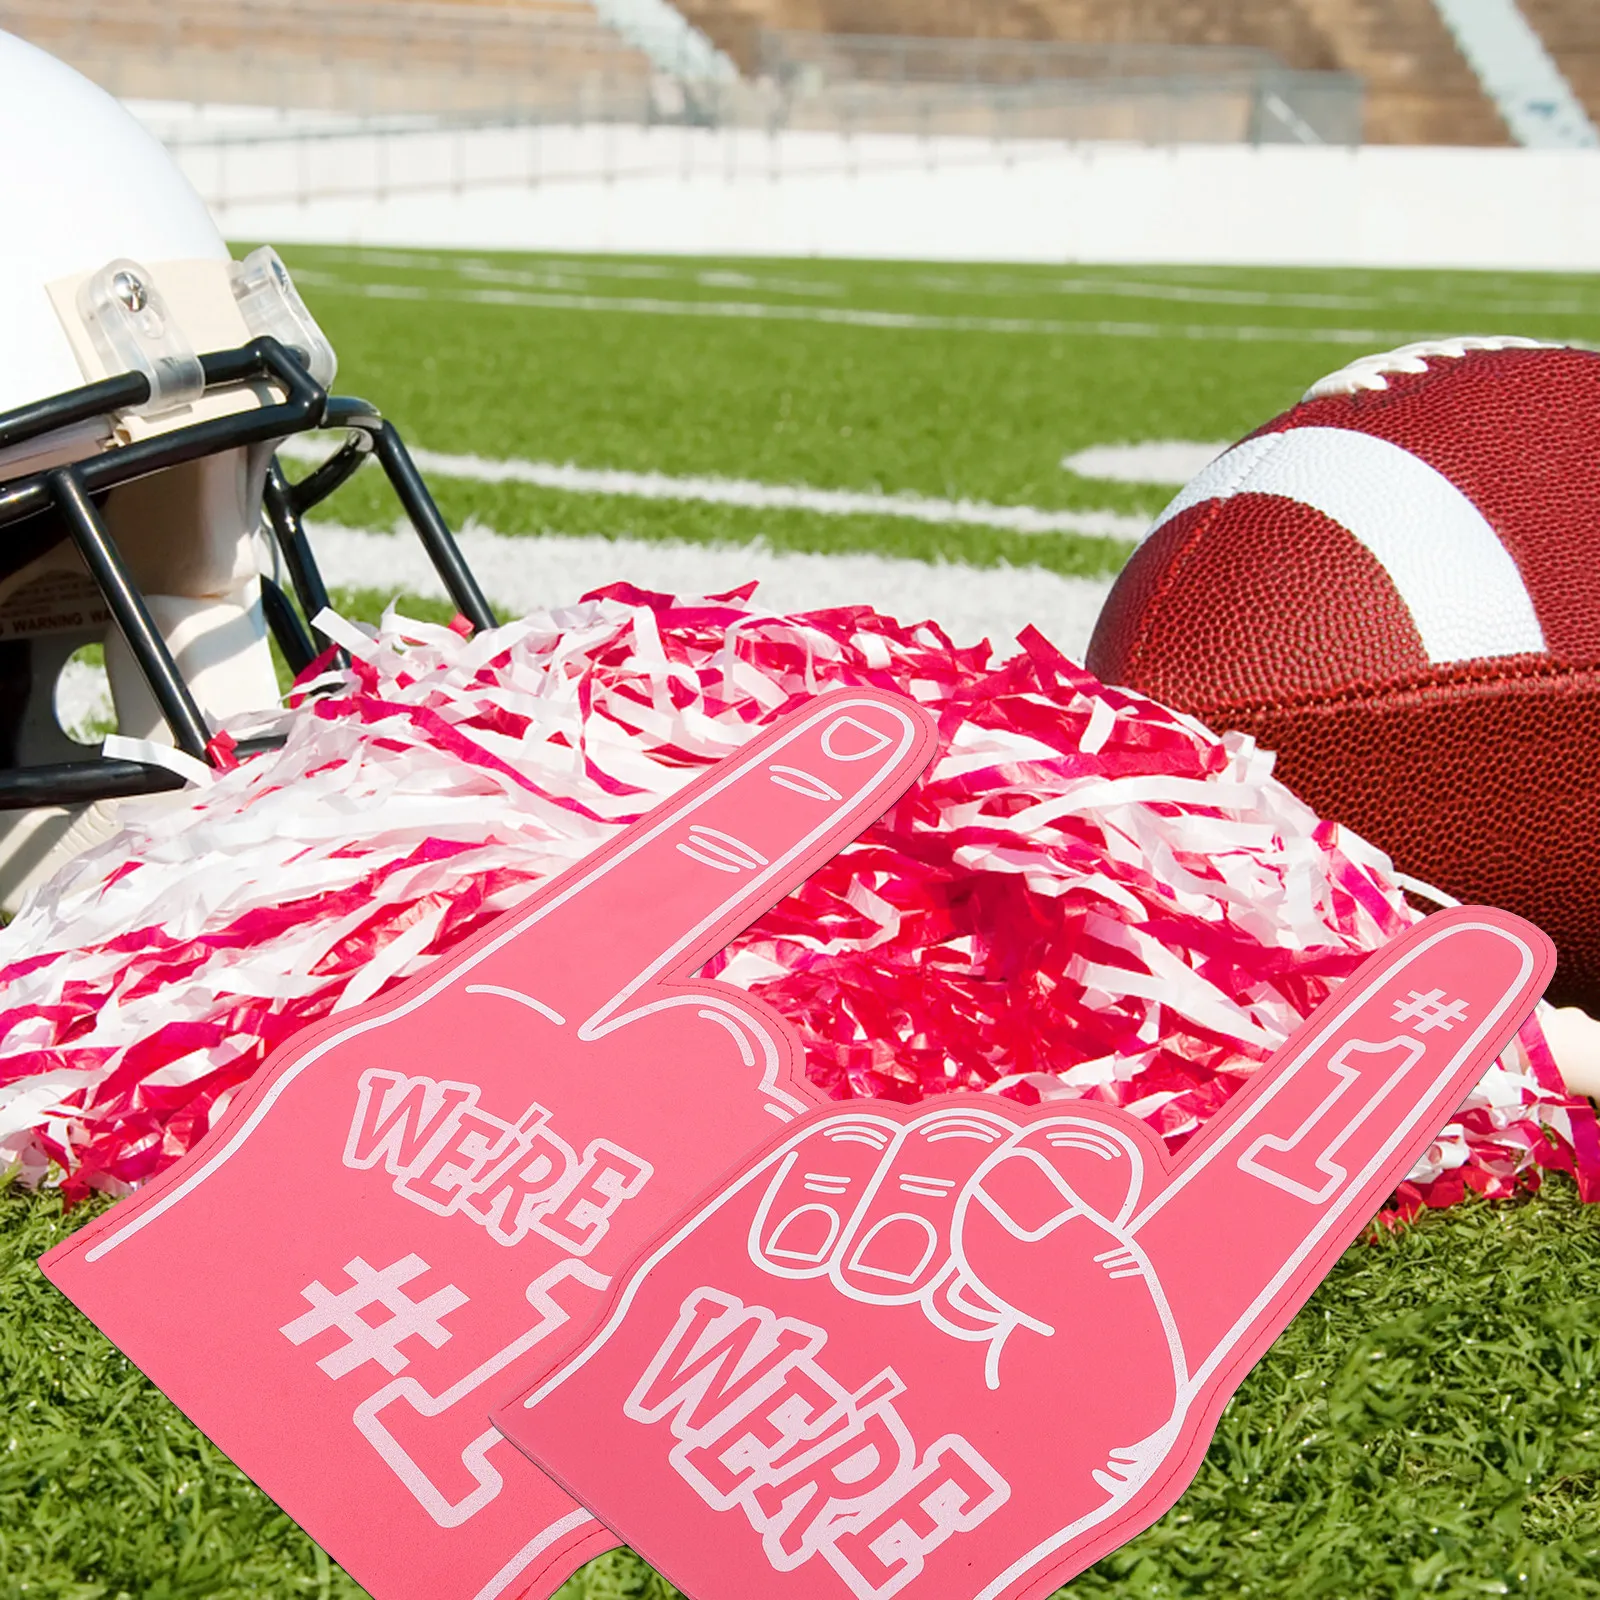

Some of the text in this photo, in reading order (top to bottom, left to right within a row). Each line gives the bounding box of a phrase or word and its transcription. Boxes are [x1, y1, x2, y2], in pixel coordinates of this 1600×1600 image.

[12, 611, 84, 634] WARNING
[342, 1067, 655, 1257] WE'RE
[623, 1286, 1011, 1600] WE'RE
